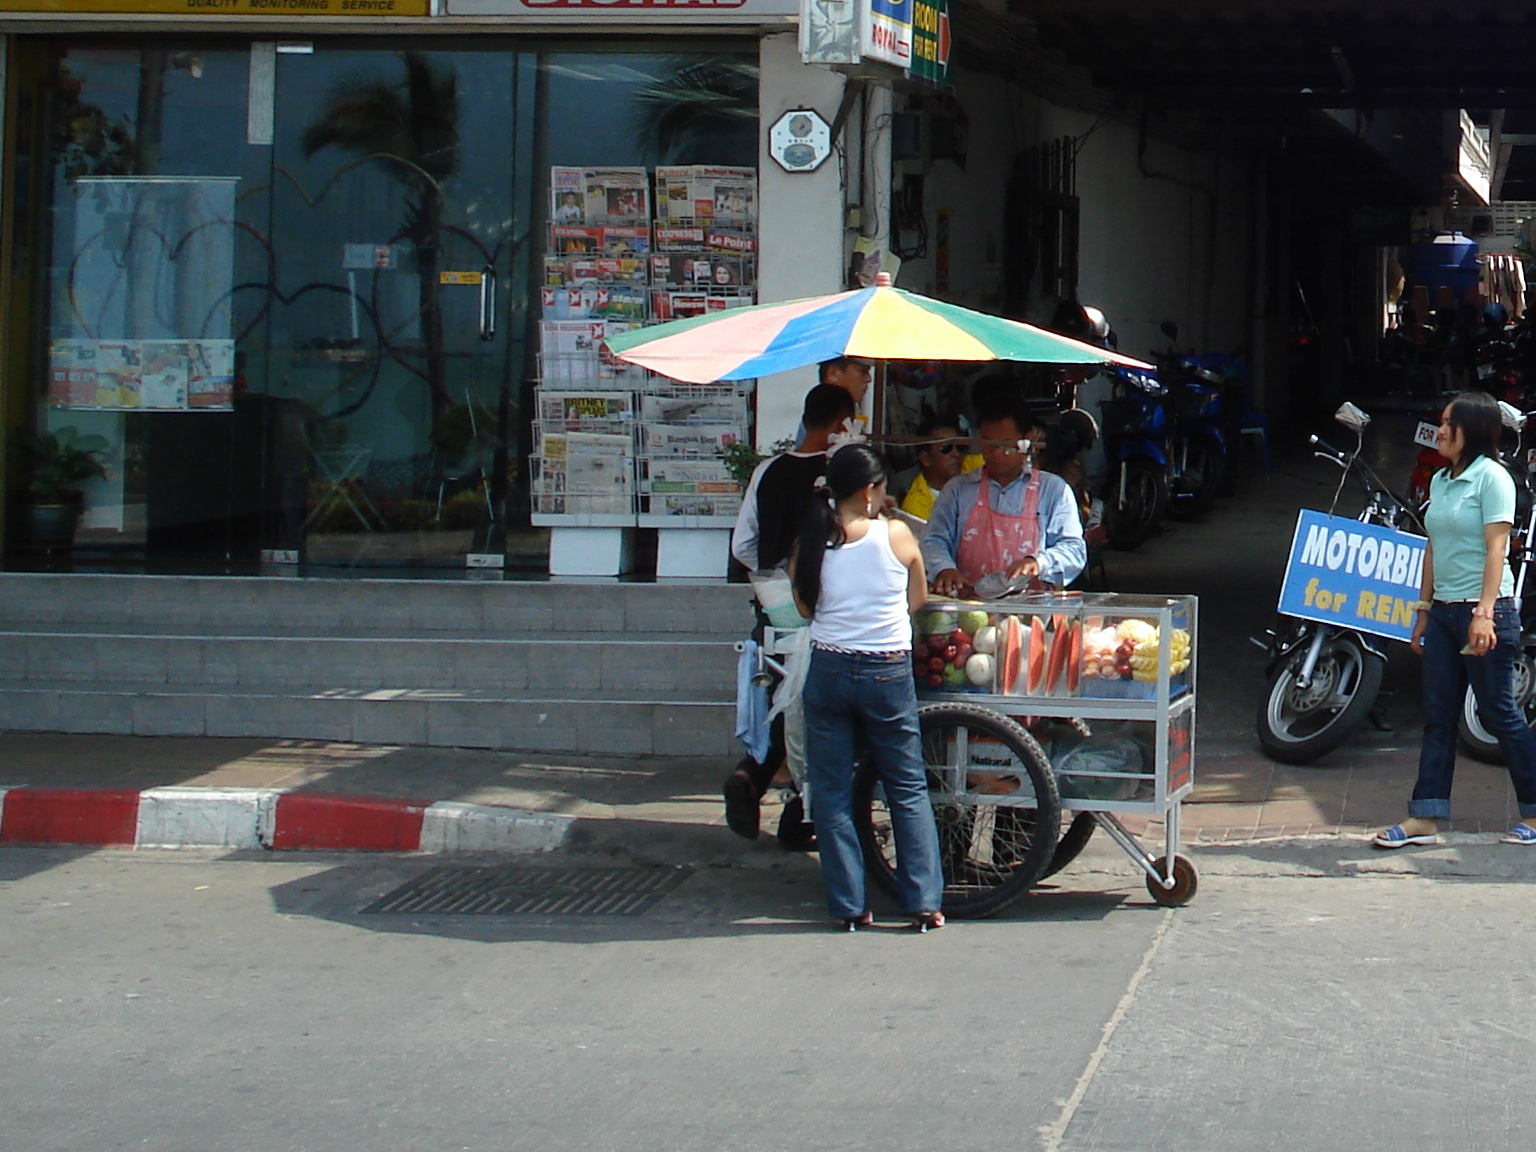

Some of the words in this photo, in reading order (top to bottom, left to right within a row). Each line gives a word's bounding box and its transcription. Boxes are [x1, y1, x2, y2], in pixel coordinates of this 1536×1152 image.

[249, 0, 329, 10] MONITORING
[341, 0, 395, 11] SERVICE
[872, 23, 898, 55] ROYAL
[709, 234, 722, 245] Le
[723, 236, 753, 249] Point
[1418, 427, 1434, 442] FOR
[1304, 577, 1348, 613] for
